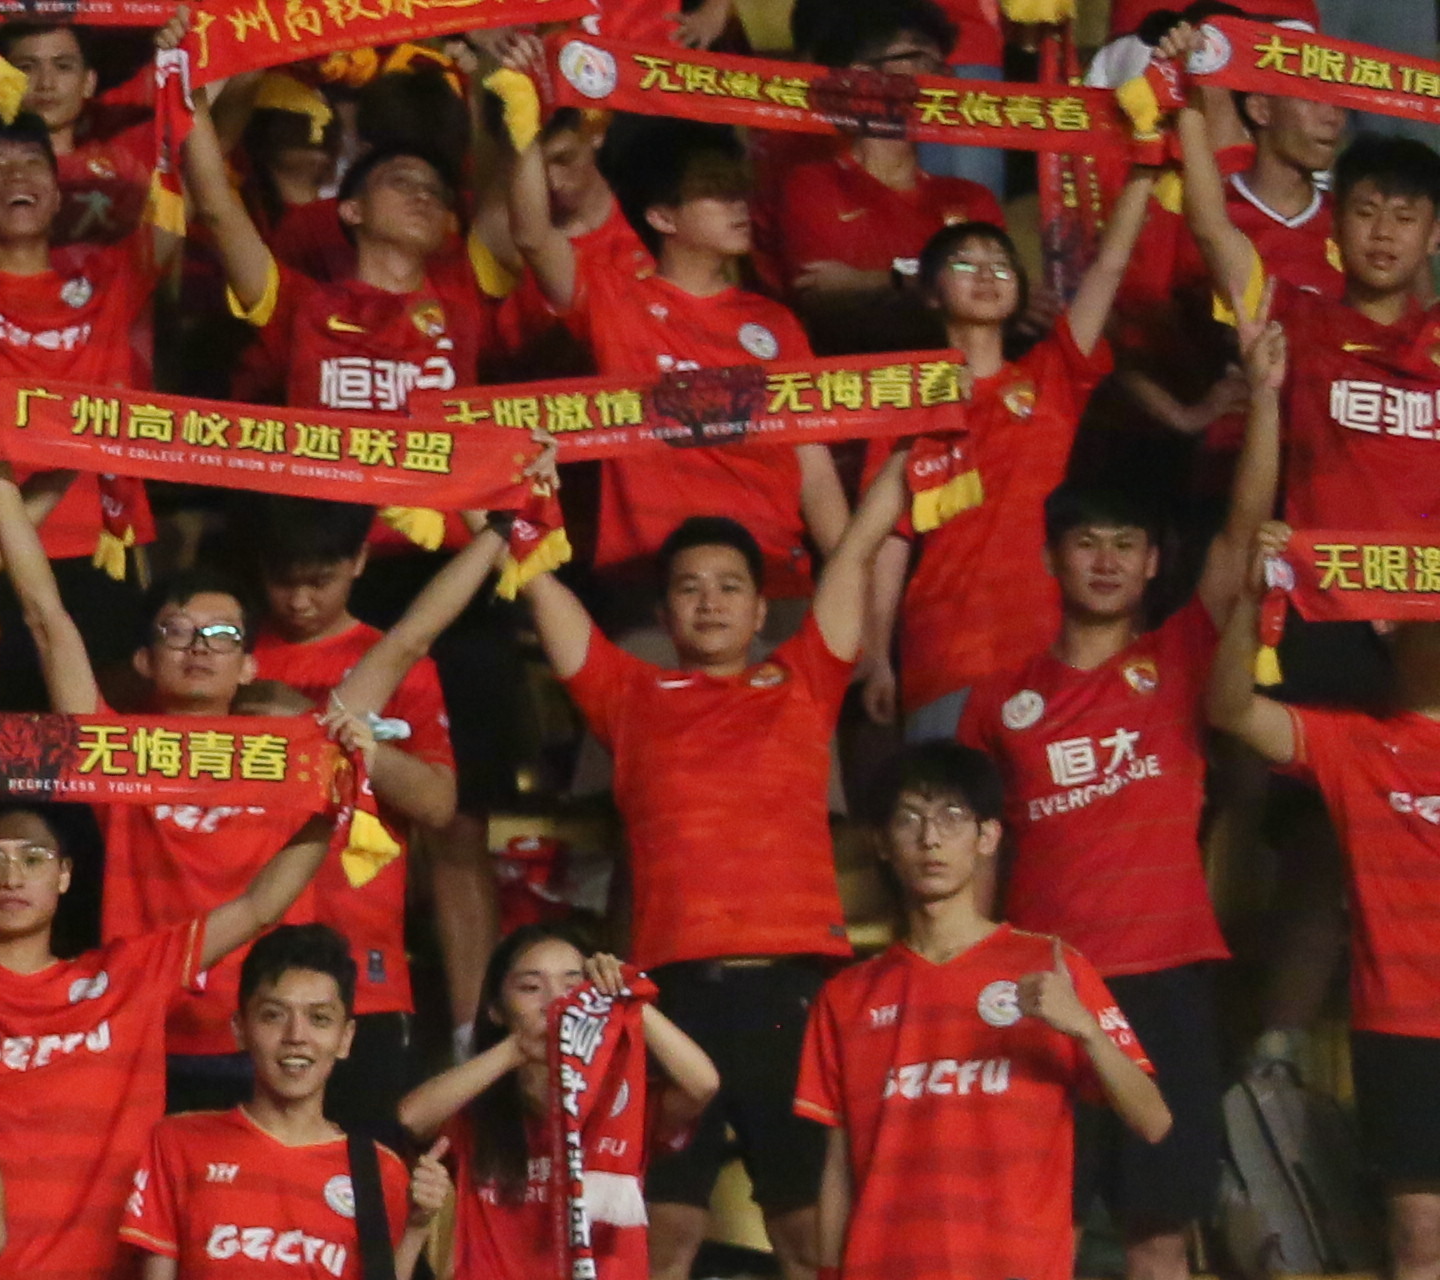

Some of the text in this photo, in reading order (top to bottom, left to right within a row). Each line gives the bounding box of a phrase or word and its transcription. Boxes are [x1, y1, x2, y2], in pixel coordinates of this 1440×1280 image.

[768, 364, 961, 413] 无悔青春
[1332, 380, 1440, 440] 恒驰
[16, 387, 454, 474] 广州高校球迷联盟
[100, 445, 363, 482] THE COLLEGE FANS UNION OF GUANGZHOU
[78, 725, 288, 781] 无悔青春
[1047, 727, 1141, 786] 恒大
[8, 780, 96, 792] REGRETLESS
[108, 782, 152, 792] YOUTH
[207, 1219, 346, 1278] GZCFU
